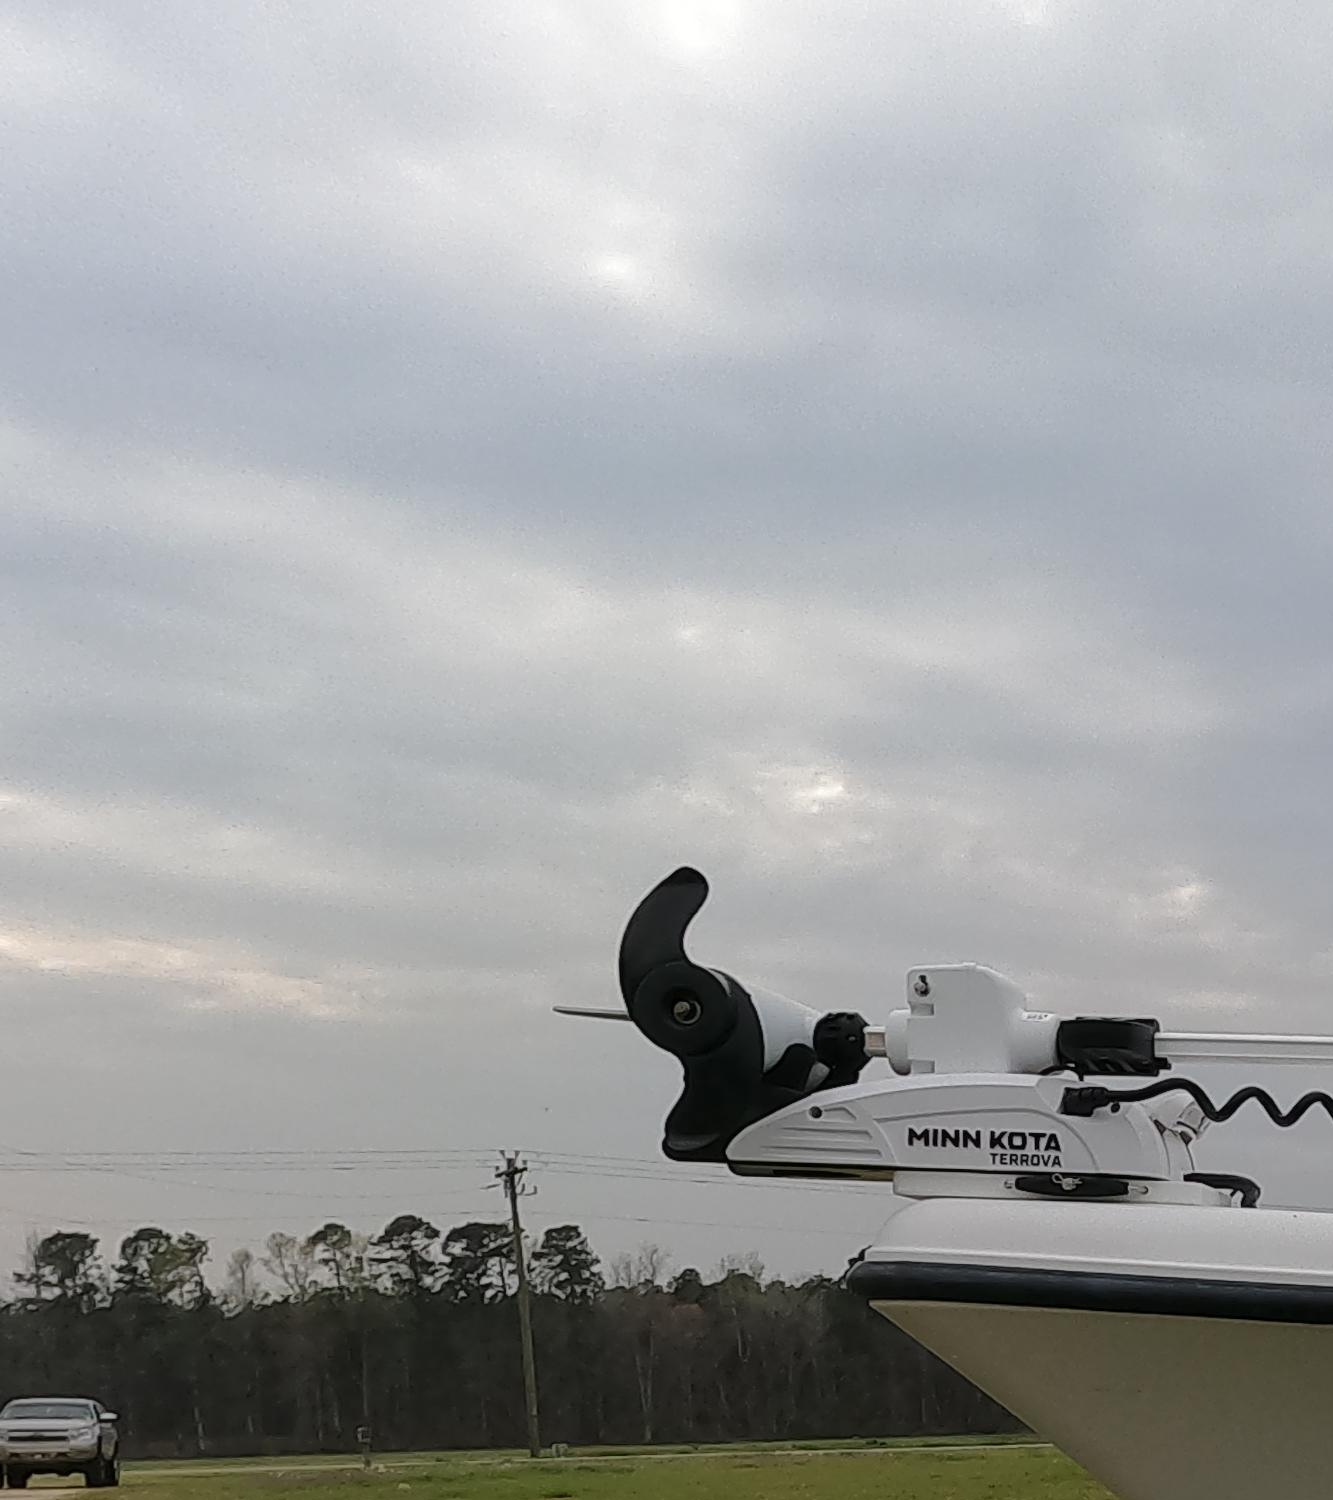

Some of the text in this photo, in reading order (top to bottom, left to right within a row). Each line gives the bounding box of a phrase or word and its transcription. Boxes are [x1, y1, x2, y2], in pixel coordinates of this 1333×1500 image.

[907, 1126, 1062, 1152] MINN KOTA
[990, 1152, 1062, 1168] TERROVA
